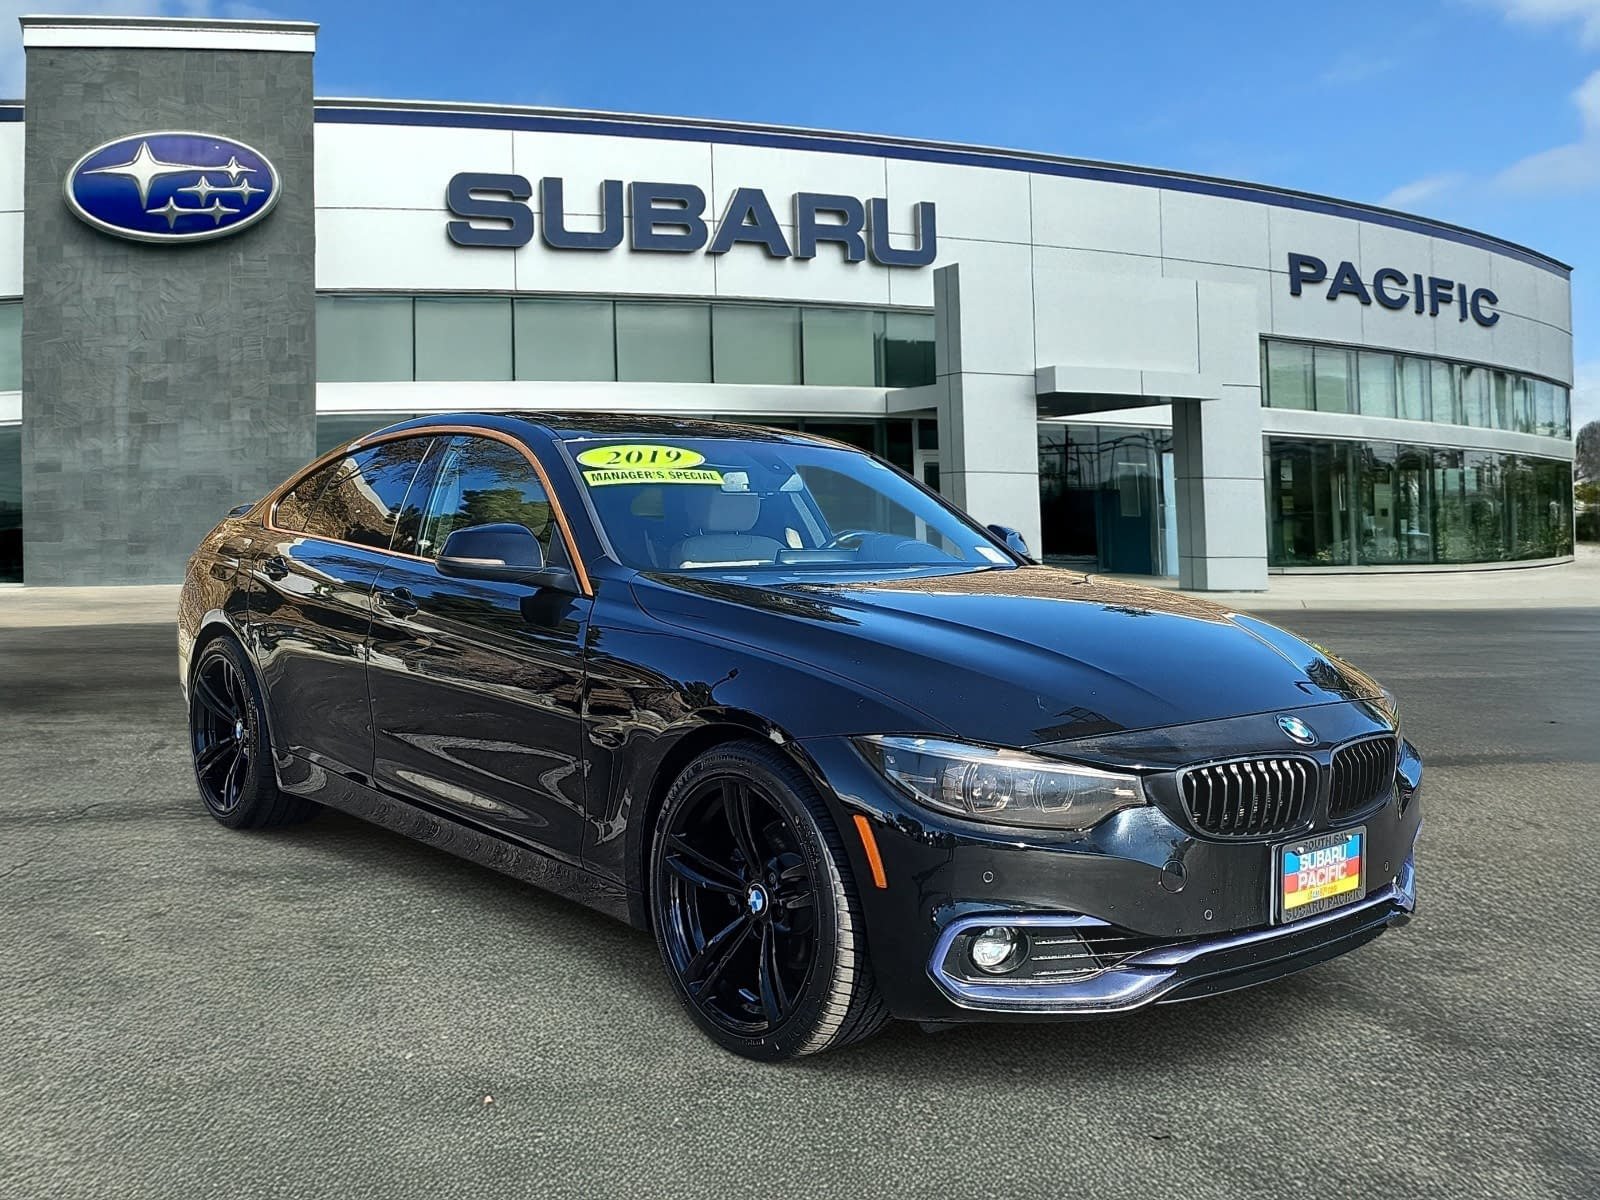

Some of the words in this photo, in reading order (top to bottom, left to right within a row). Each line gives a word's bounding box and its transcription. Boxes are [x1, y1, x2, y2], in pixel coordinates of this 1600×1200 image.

[447, 172, 937, 268] SUBARU
[1288, 252, 1500, 327] PACIFIC
[606, 450, 682, 465] 2019
[591, 470, 664, 482] MANAGER'S
[670, 471, 718, 481] SPECIAL
[1299, 844, 1347, 871] SUBARU
[1298, 862, 1347, 891] PACIFIC
[1286, 899, 1325, 921] SUBARU
[1327, 889, 1363, 909] PACIFIC
